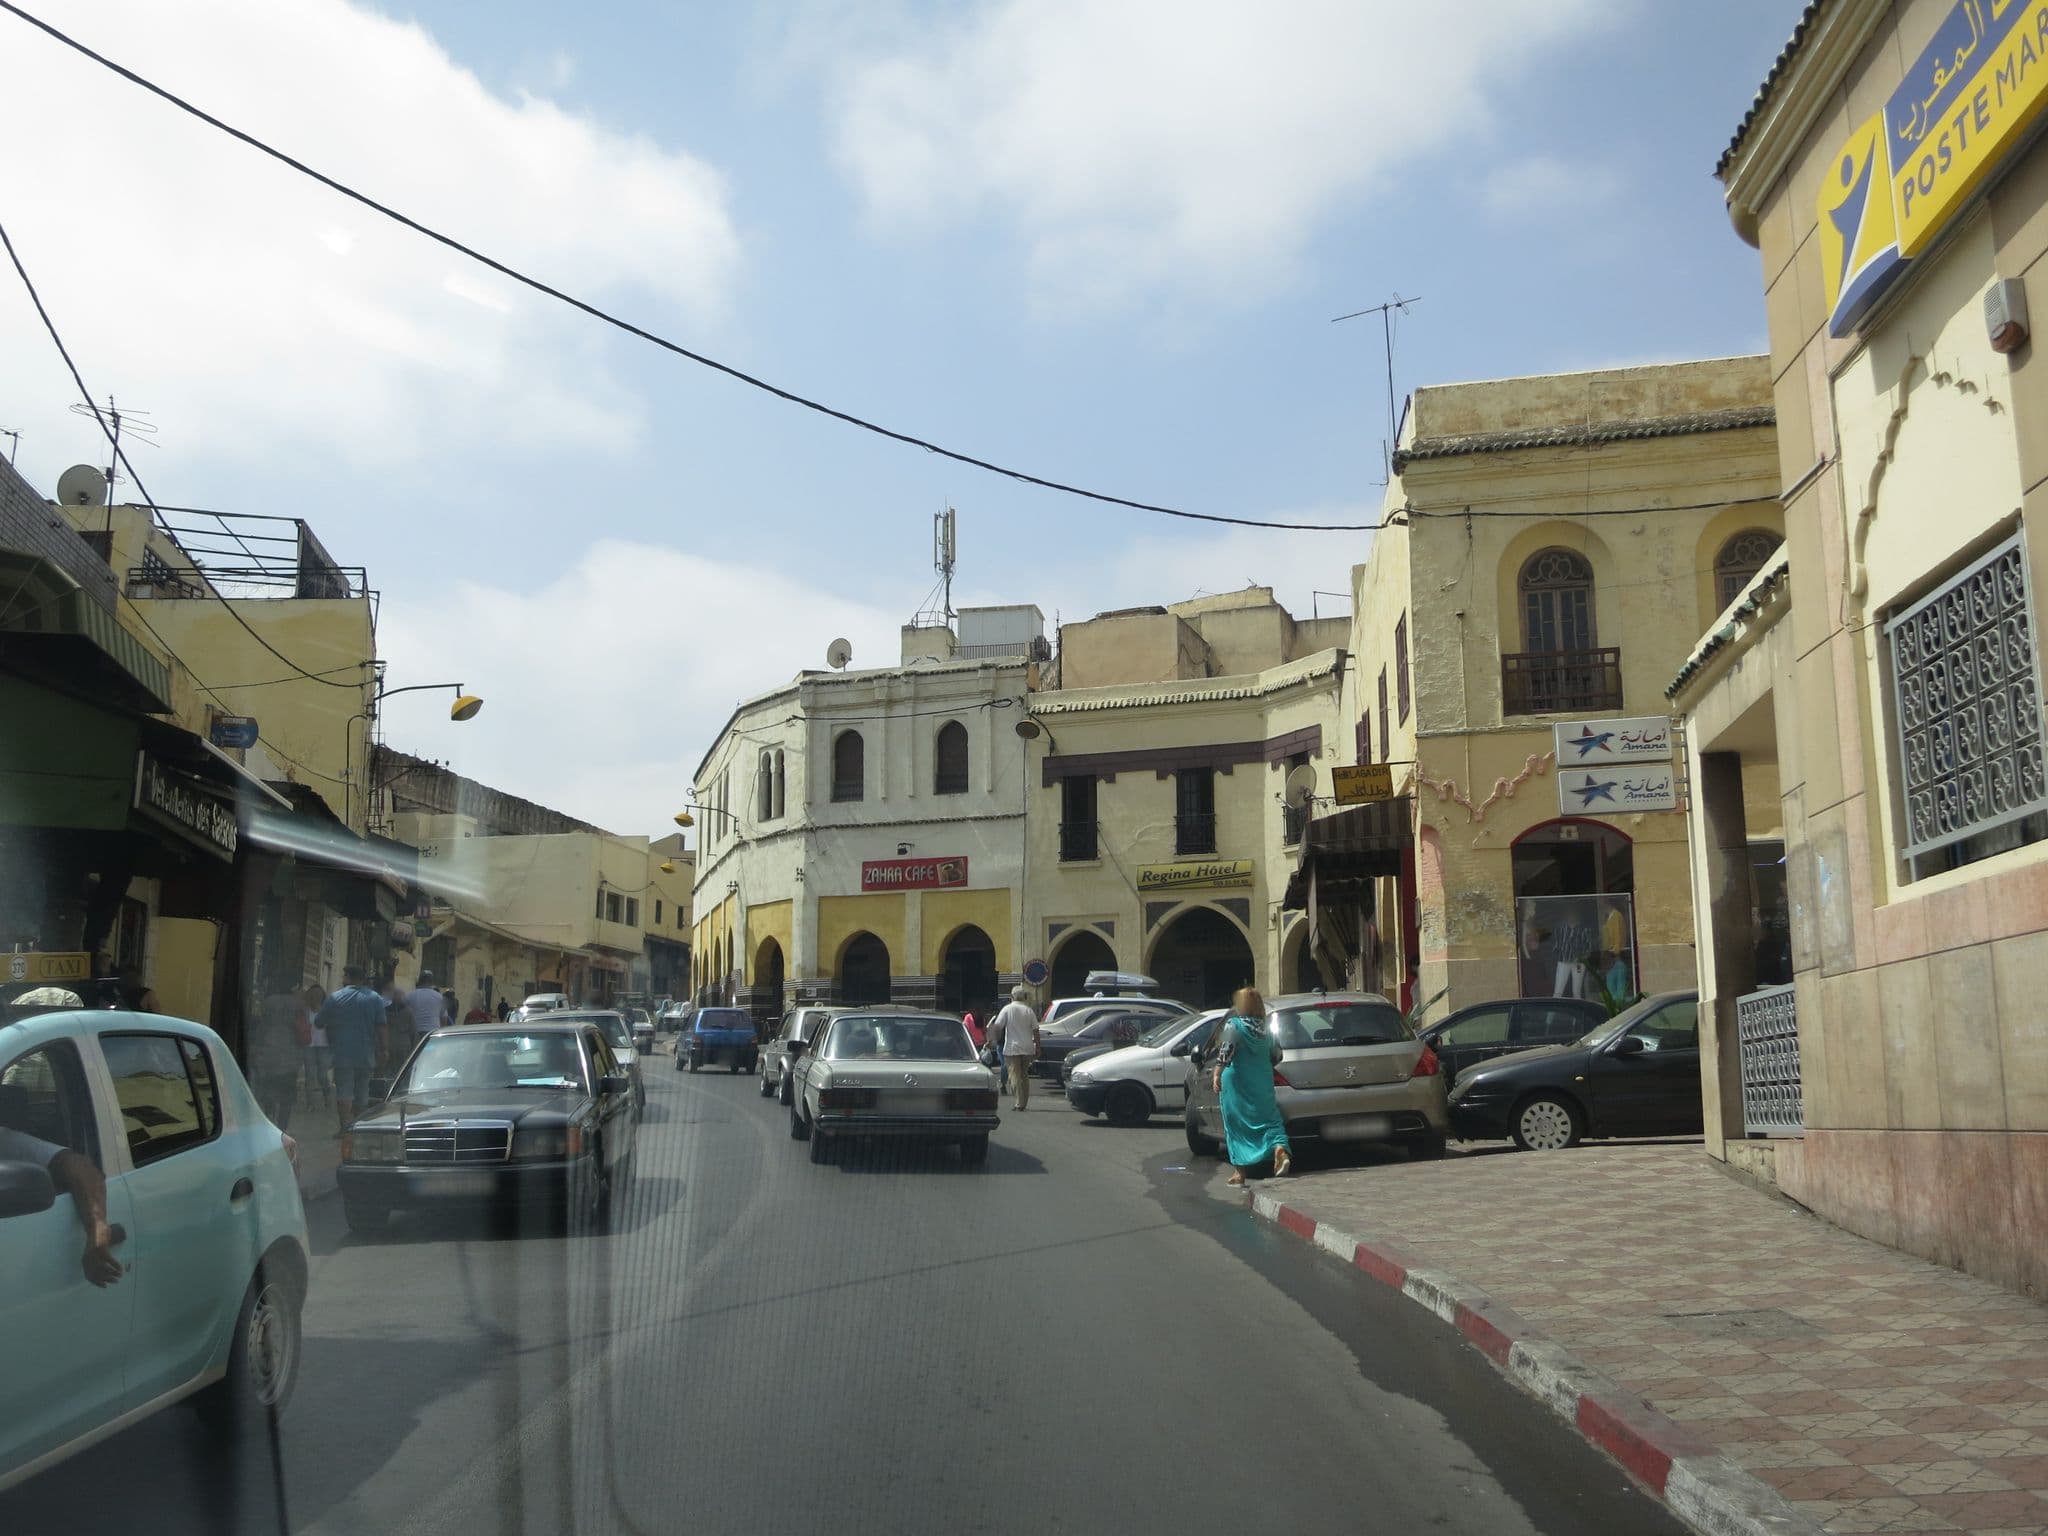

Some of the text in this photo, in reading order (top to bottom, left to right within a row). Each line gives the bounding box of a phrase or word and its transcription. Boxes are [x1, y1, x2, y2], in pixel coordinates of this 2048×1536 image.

[1903, 85, 1991, 219] POSTE
[1620, 728, 1667, 743] أمانة
[1621, 742, 1667, 752] Amana
[1623, 777, 1670, 792] أمانة
[1624, 791, 1670, 800] Amana
[865, 866, 902, 884] ZAHRA
[1141, 862, 1238, 884] Regina Hôtel
[46, 959, 81, 976] TAXI
